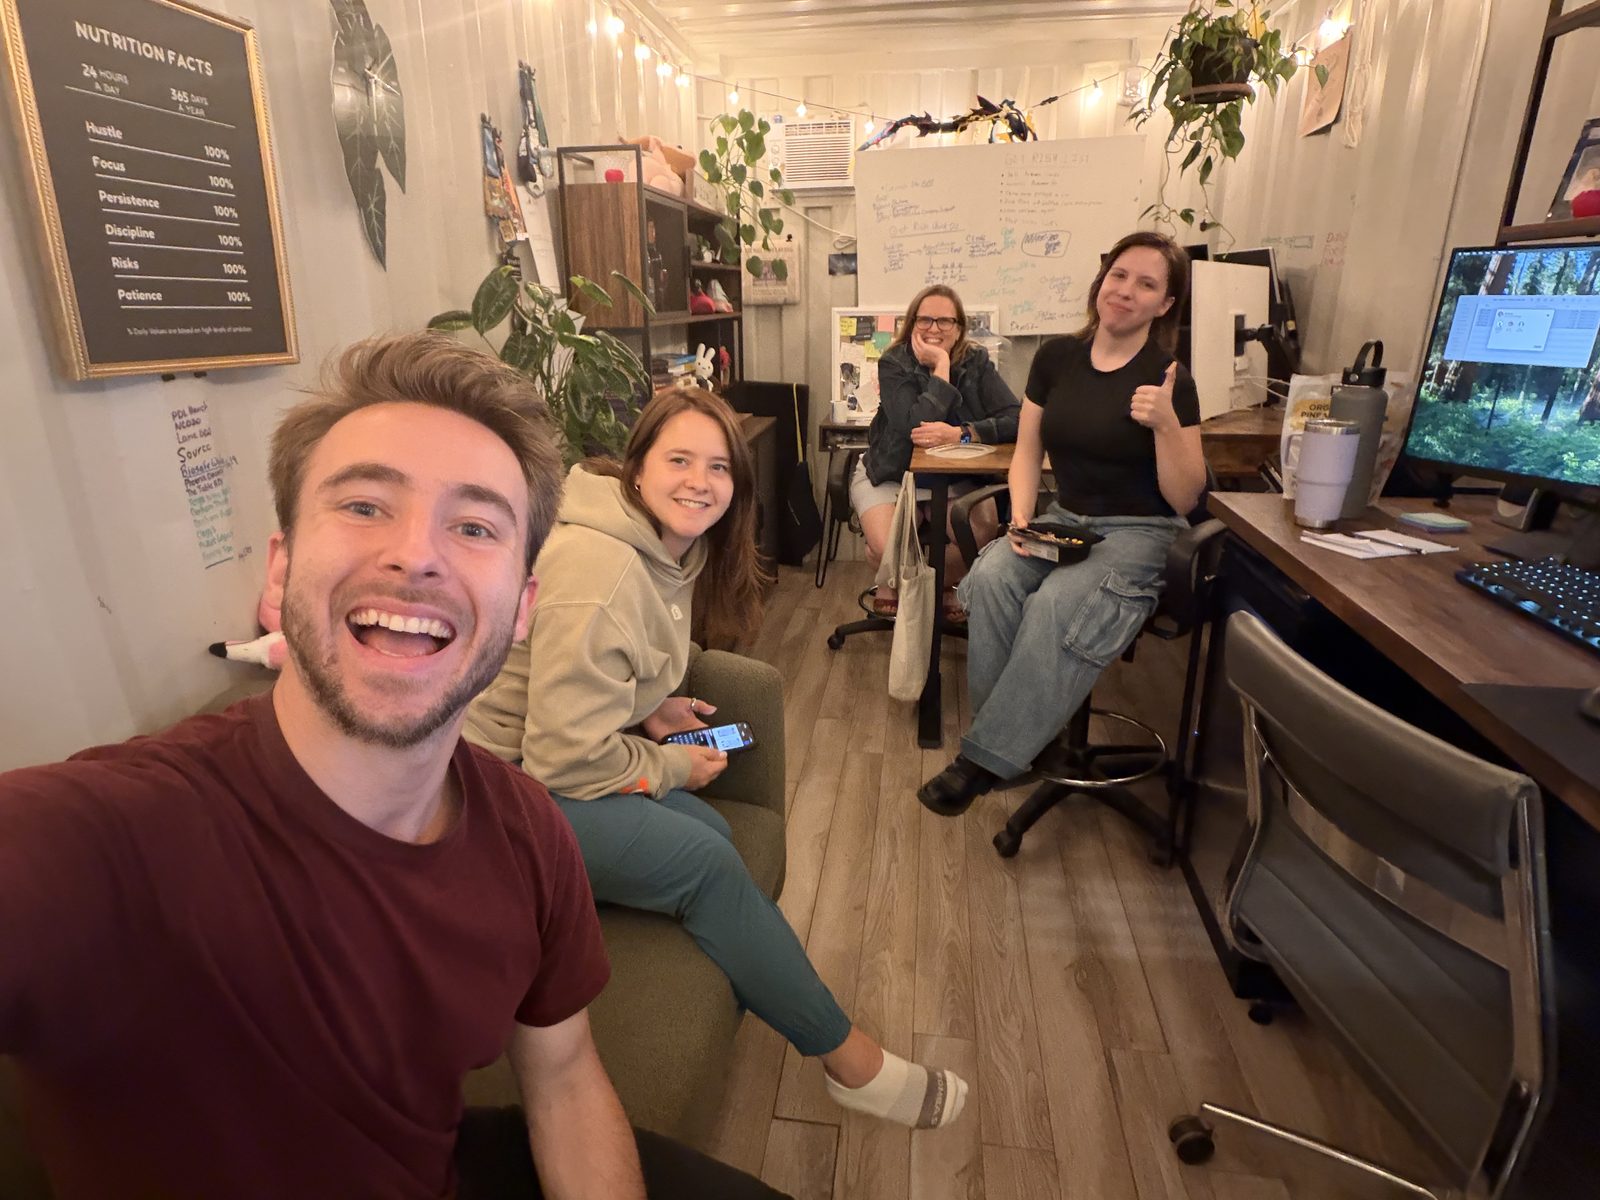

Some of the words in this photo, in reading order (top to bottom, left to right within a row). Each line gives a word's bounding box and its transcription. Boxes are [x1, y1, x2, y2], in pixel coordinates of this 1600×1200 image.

[74, 20, 166, 62] NUTRITION
[167, 49, 214, 77] FACTS
[81, 63, 98, 78] 24
[99, 69, 129, 85] HOURS
[94, 81, 101, 90] A
[104, 84, 120, 95] DAY
[170, 88, 189, 103] 365
[190, 94, 209, 106] DAYS
[178, 104, 184, 112] A
[185, 105, 206, 117] YEAR
[85, 120, 123, 139] Hustle
[204, 145, 230, 160] 100%
[92, 155, 126, 172] Focus
[209, 175, 234, 190] 100%
[98, 189, 160, 209] Persistence
[213, 205, 238, 218] 100%
[105, 223, 155, 240] Discipline
[218, 234, 243, 247] 100%
[111, 256, 140, 270] Risks
[223, 263, 247, 275] 100%
[117, 289, 163, 301] Patience
[227, 291, 251, 302] 100%
